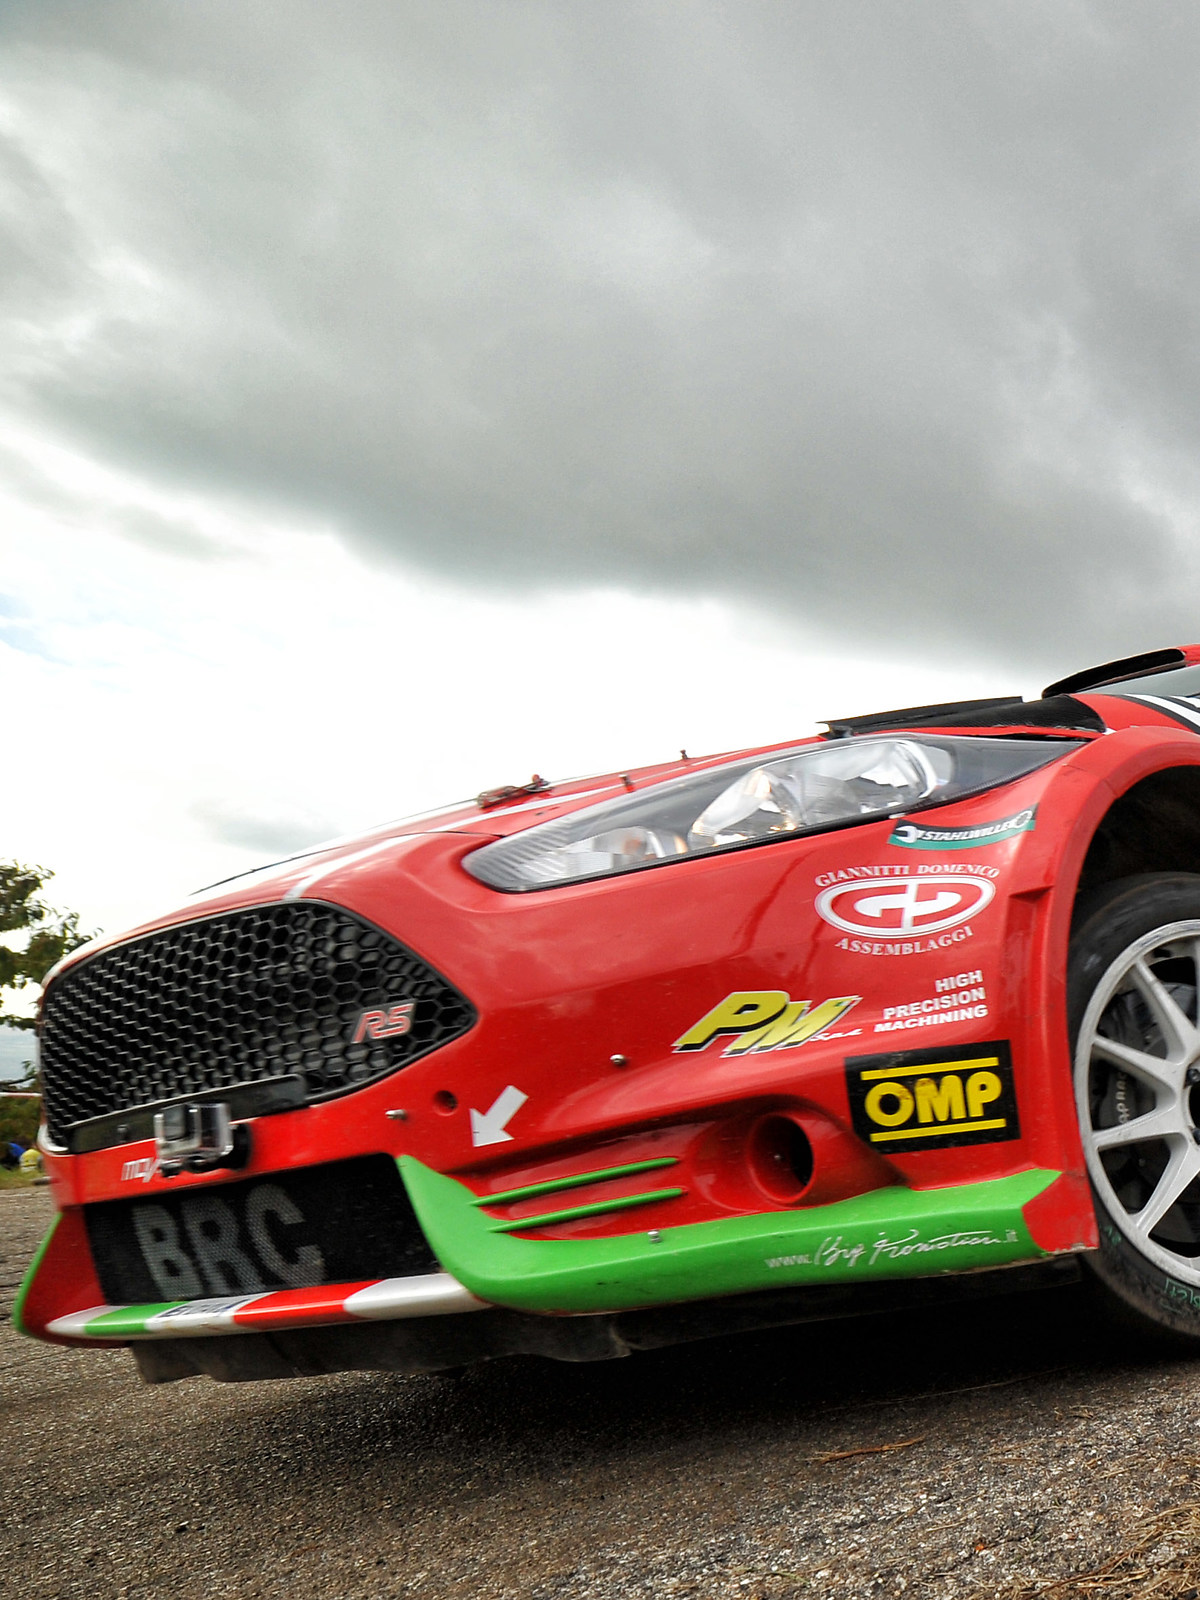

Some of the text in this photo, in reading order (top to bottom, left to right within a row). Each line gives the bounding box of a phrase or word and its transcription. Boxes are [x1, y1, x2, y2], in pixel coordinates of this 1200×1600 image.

[814, 864, 1000, 887] GIANNITTI DOMENICO
[835, 926, 974, 955] ASSEMBLAGGI
[935, 970, 983, 992] HIGH
[883, 987, 986, 1019] PRECISION
[873, 1005, 988, 1032] MACHINING
[865, 1071, 1002, 1127] OMP
[132, 1184, 326, 1300] BRC
